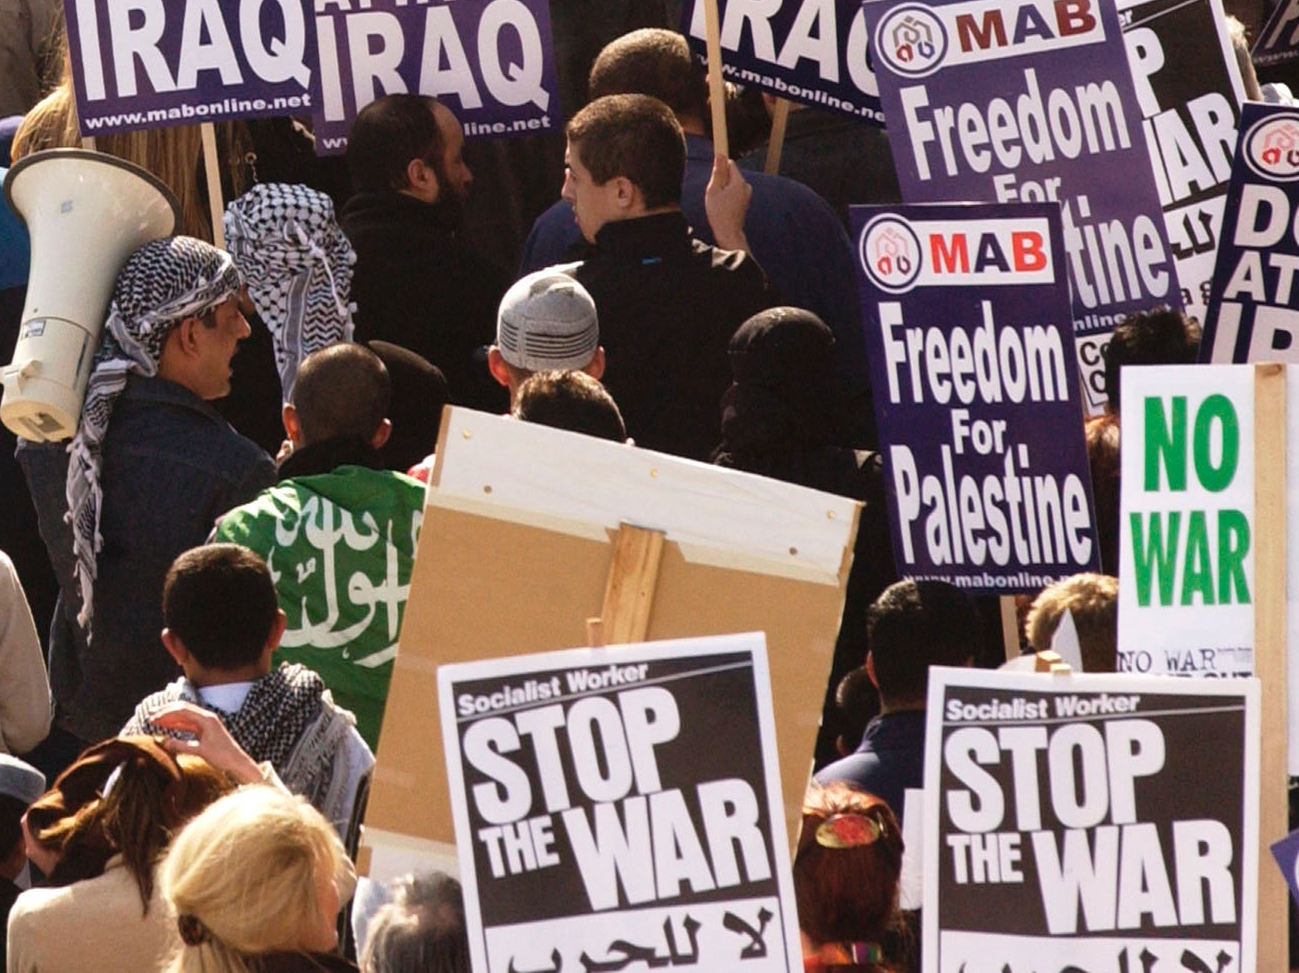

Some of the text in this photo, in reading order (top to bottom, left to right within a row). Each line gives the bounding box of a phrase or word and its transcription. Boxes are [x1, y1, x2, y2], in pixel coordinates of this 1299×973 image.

[85, 92, 312, 129] www.mabonline.net
[900, 68, 1132, 181] Freedom
[929, 230, 1047, 274] MAB
[878, 300, 1069, 405] Freedom
[952, 409, 1006, 455] For
[1144, 393, 1240, 492] NO
[890, 443, 1093, 567] Palestine
[1130, 509, 1251, 607] WAR
[458, 662, 649, 715] Socialist Worker
[947, 693, 1140, 721] Socialist Worker
[1165, 648, 1217, 672] WAR
[463, 686, 681, 825] STOP
[944, 719, 1165, 833] STOP
[478, 779, 771, 911] THE WAR
[946, 819, 1236, 935] THE WAR
[723, 907, 774, 960] لا
